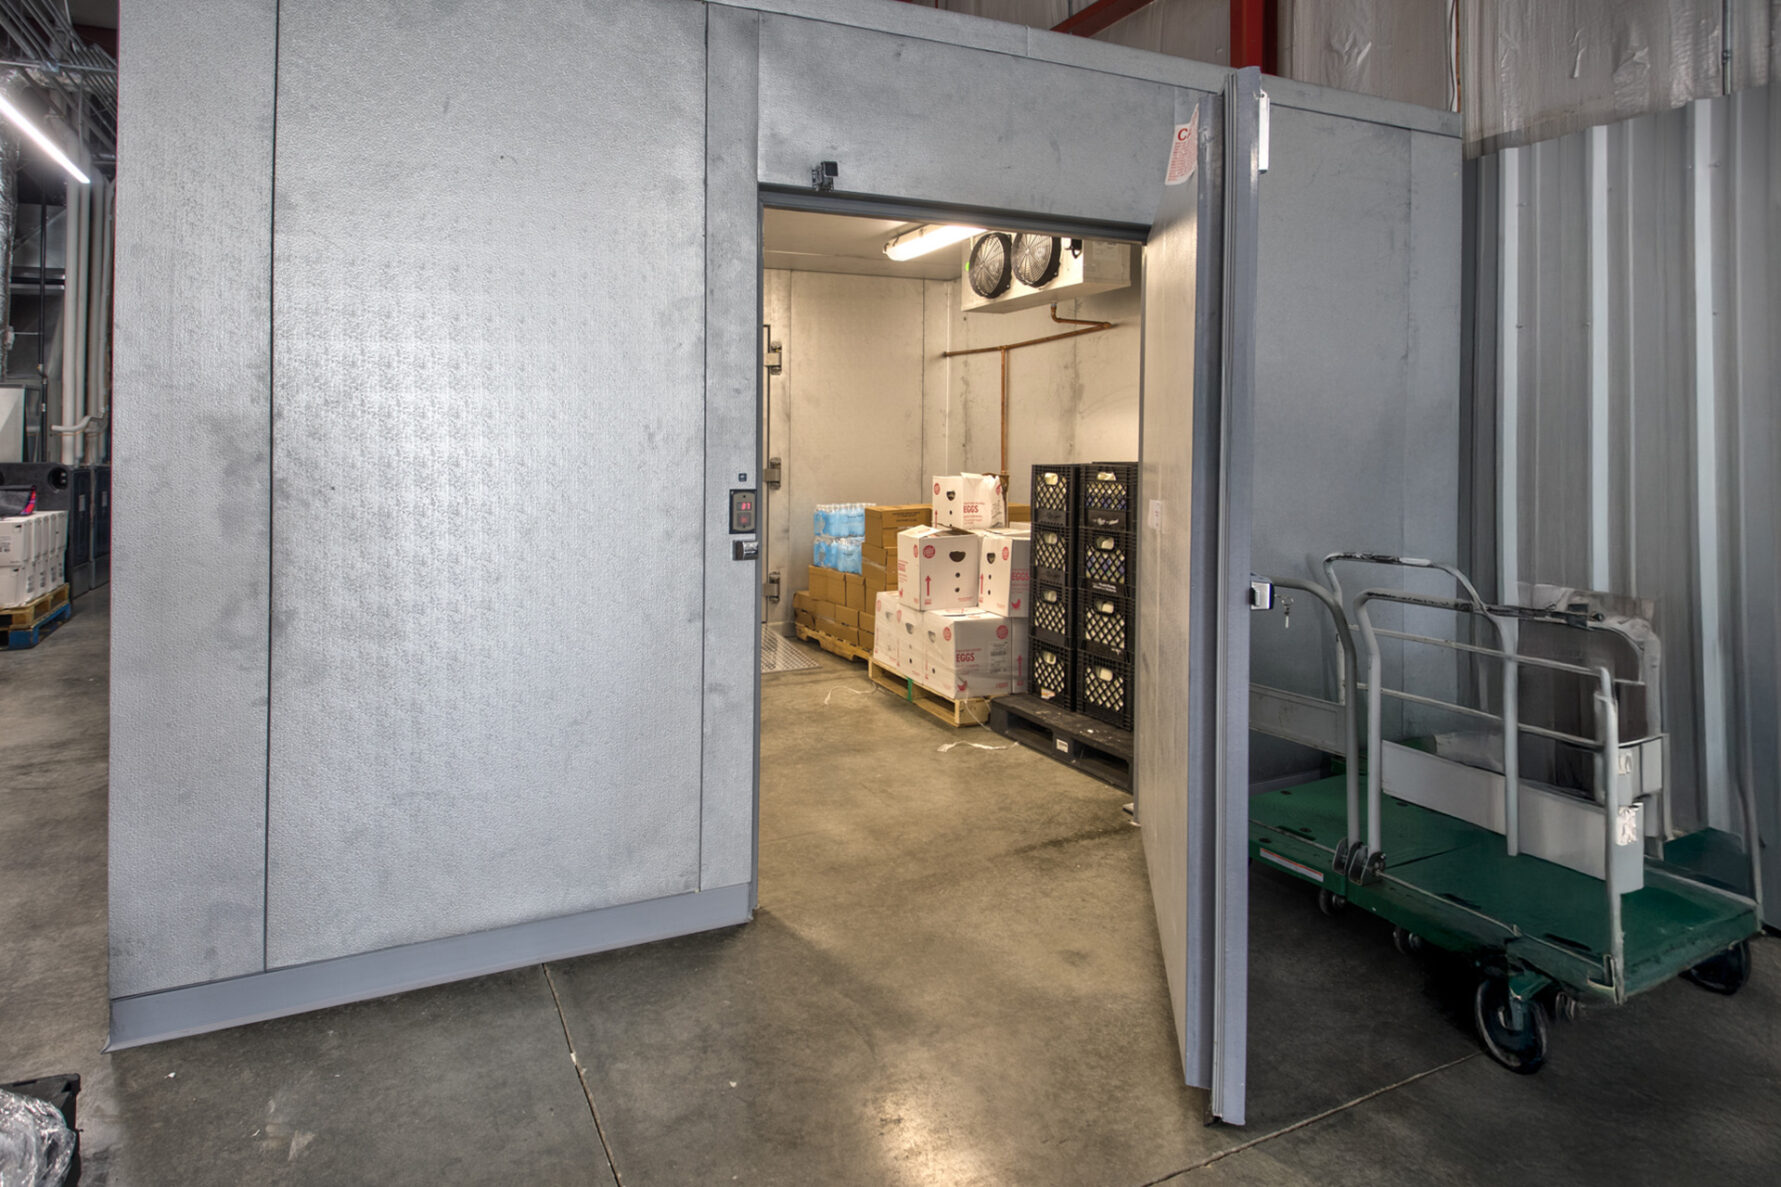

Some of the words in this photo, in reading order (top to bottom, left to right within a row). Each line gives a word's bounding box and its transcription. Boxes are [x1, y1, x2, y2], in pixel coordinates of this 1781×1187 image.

[963, 504, 979, 513] EGGS
[1011, 571, 1030, 581] EGGS
[955, 652, 975, 663] EGGS
